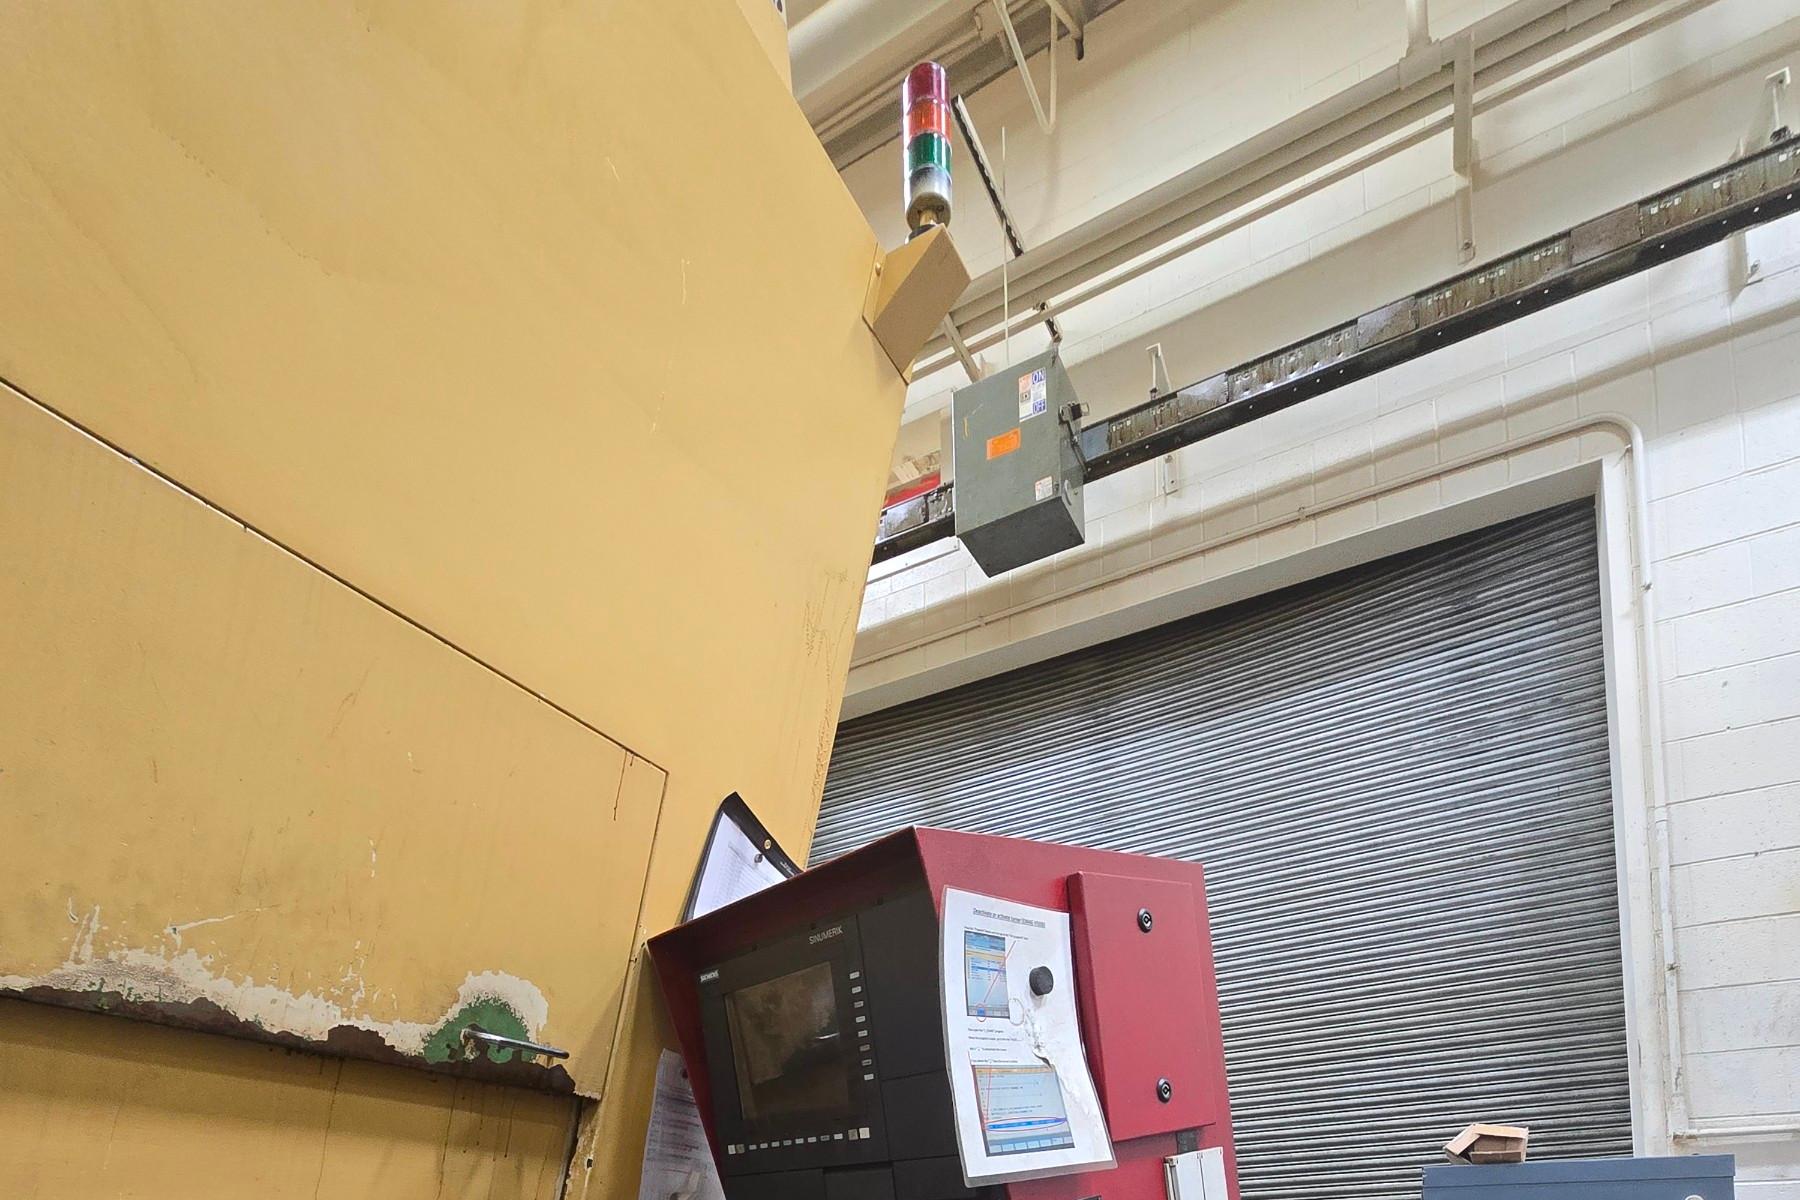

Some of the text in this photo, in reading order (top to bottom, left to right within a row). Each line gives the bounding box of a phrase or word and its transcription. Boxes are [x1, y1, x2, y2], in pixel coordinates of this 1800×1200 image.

[1033, 369, 1045, 384] ON
[1033, 400, 1045, 414] OFF
[808, 925, 844, 945] SINUMERIK
